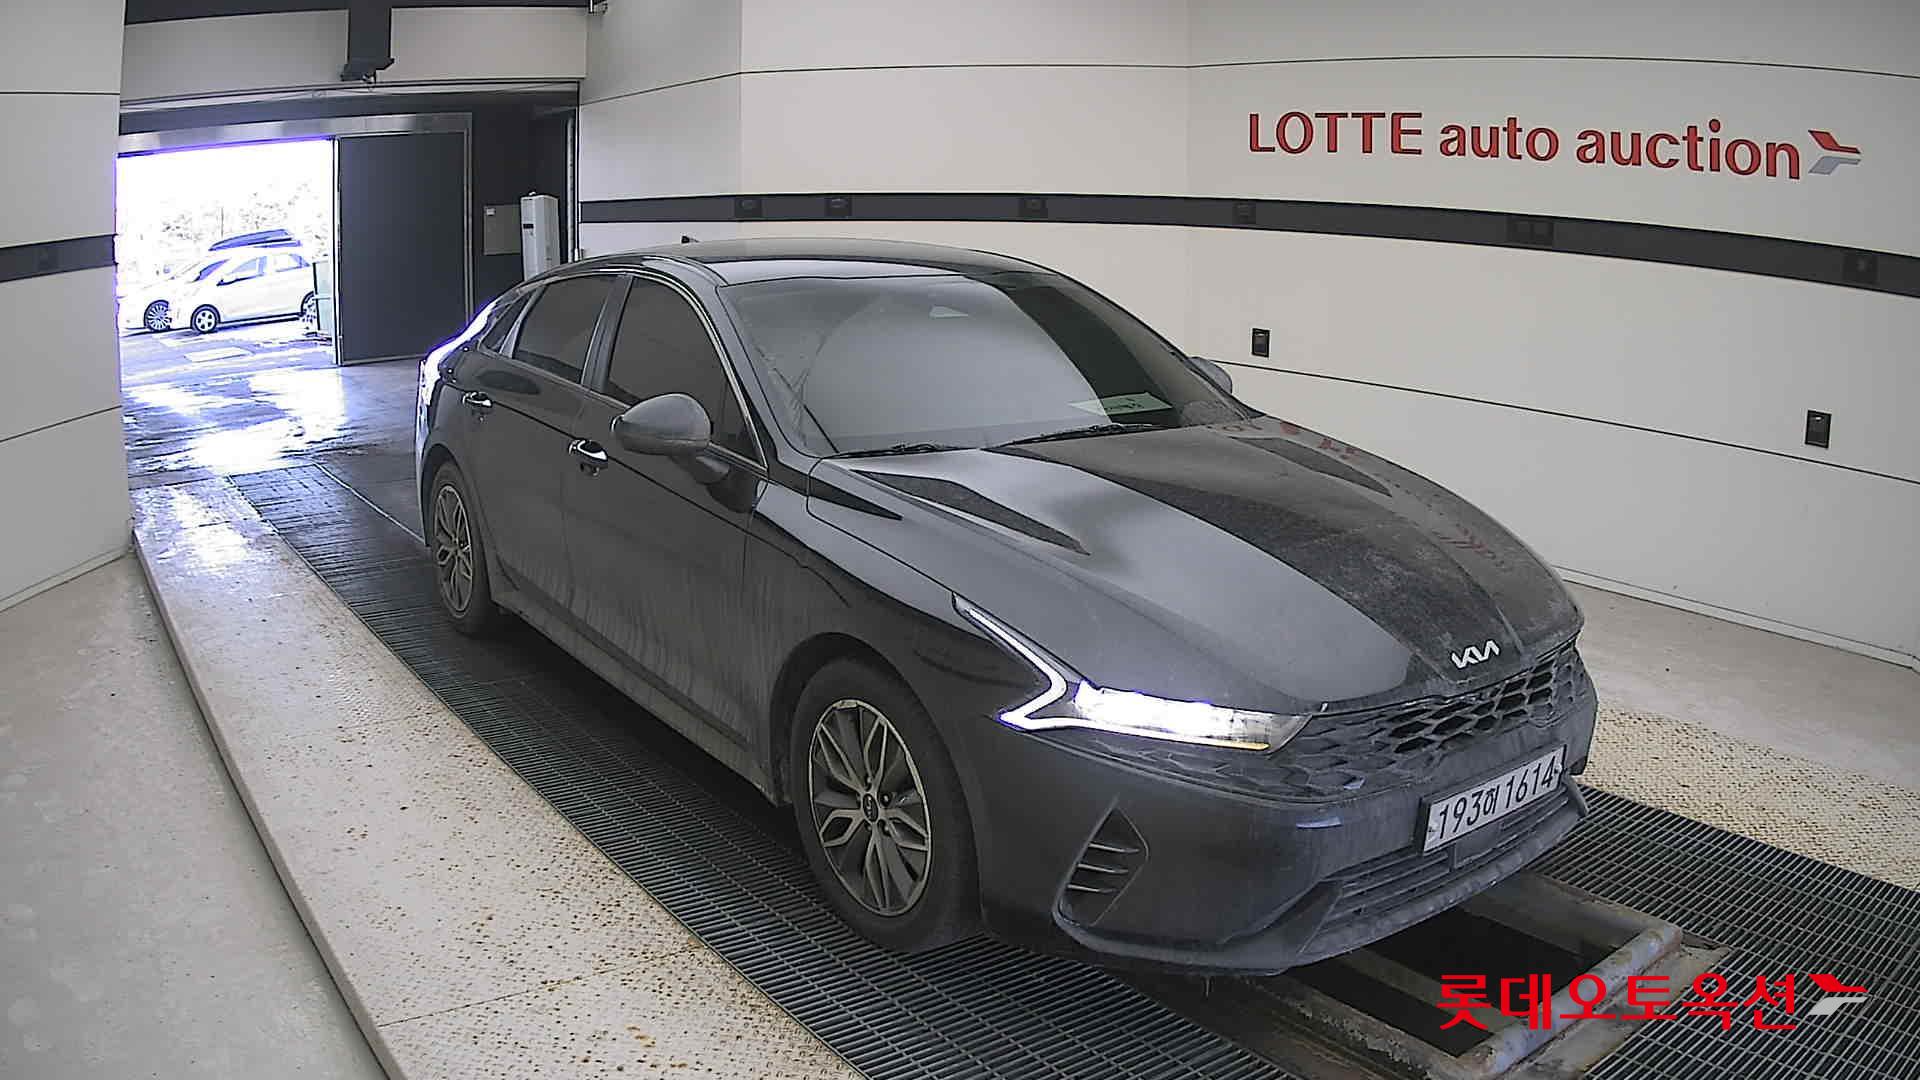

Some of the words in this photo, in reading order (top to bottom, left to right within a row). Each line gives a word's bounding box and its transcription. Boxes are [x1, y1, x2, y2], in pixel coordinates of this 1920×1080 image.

[1250, 112, 1422, 155] LOTTE
[1440, 117, 1559, 161] auto
[1577, 119, 1800, 180] auction
